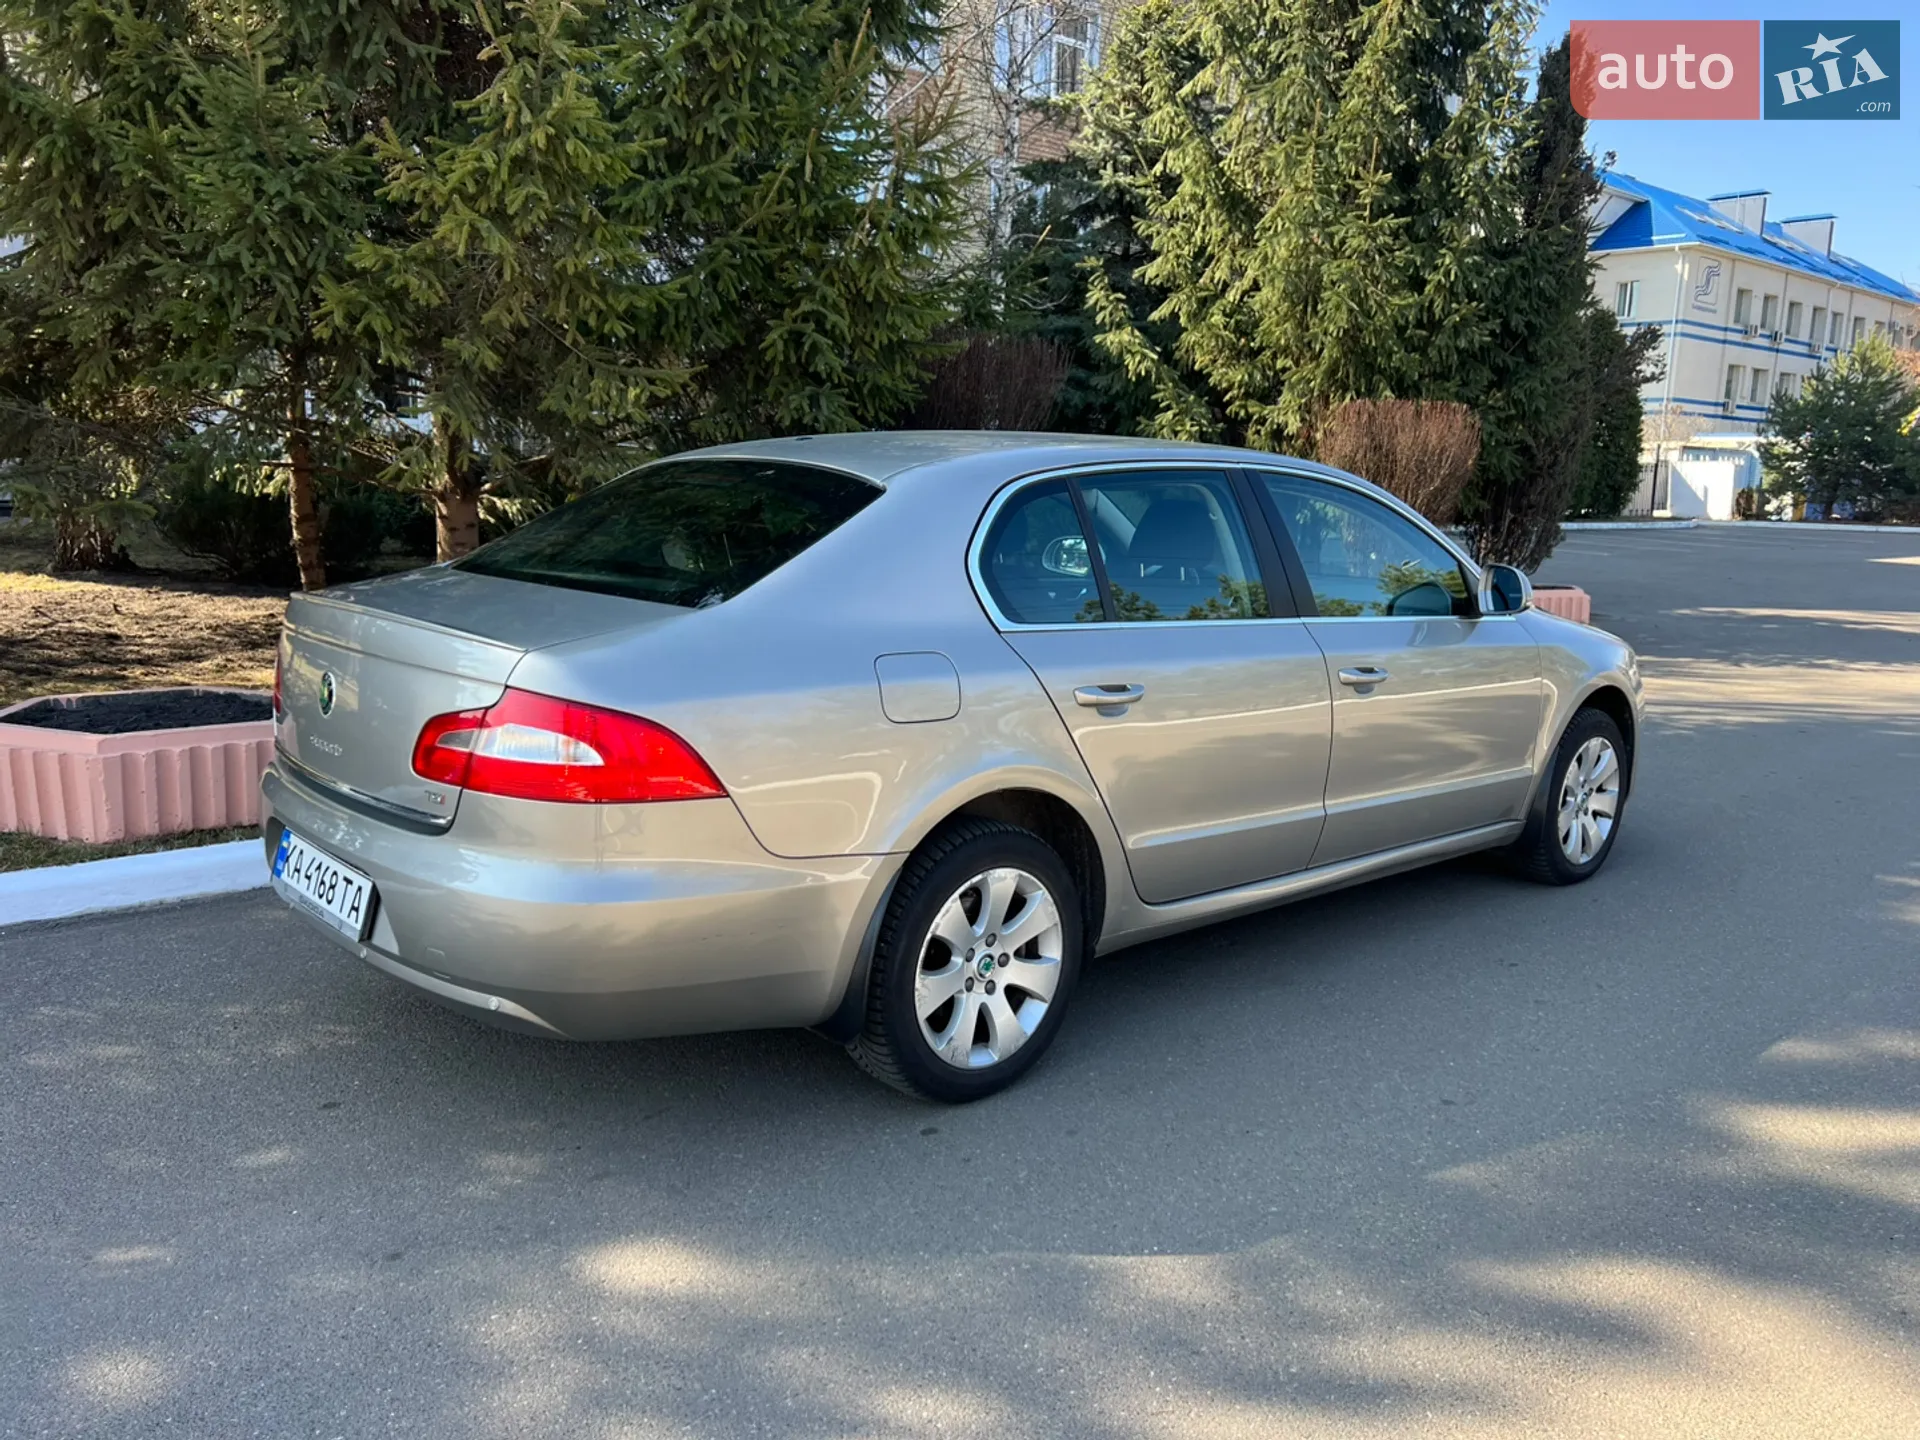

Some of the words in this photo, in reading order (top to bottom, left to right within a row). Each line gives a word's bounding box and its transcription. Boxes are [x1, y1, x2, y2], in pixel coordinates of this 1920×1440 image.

[284, 844, 304, 884] KA
[304, 857, 339, 905] 4168
[339, 875, 363, 925] TA
